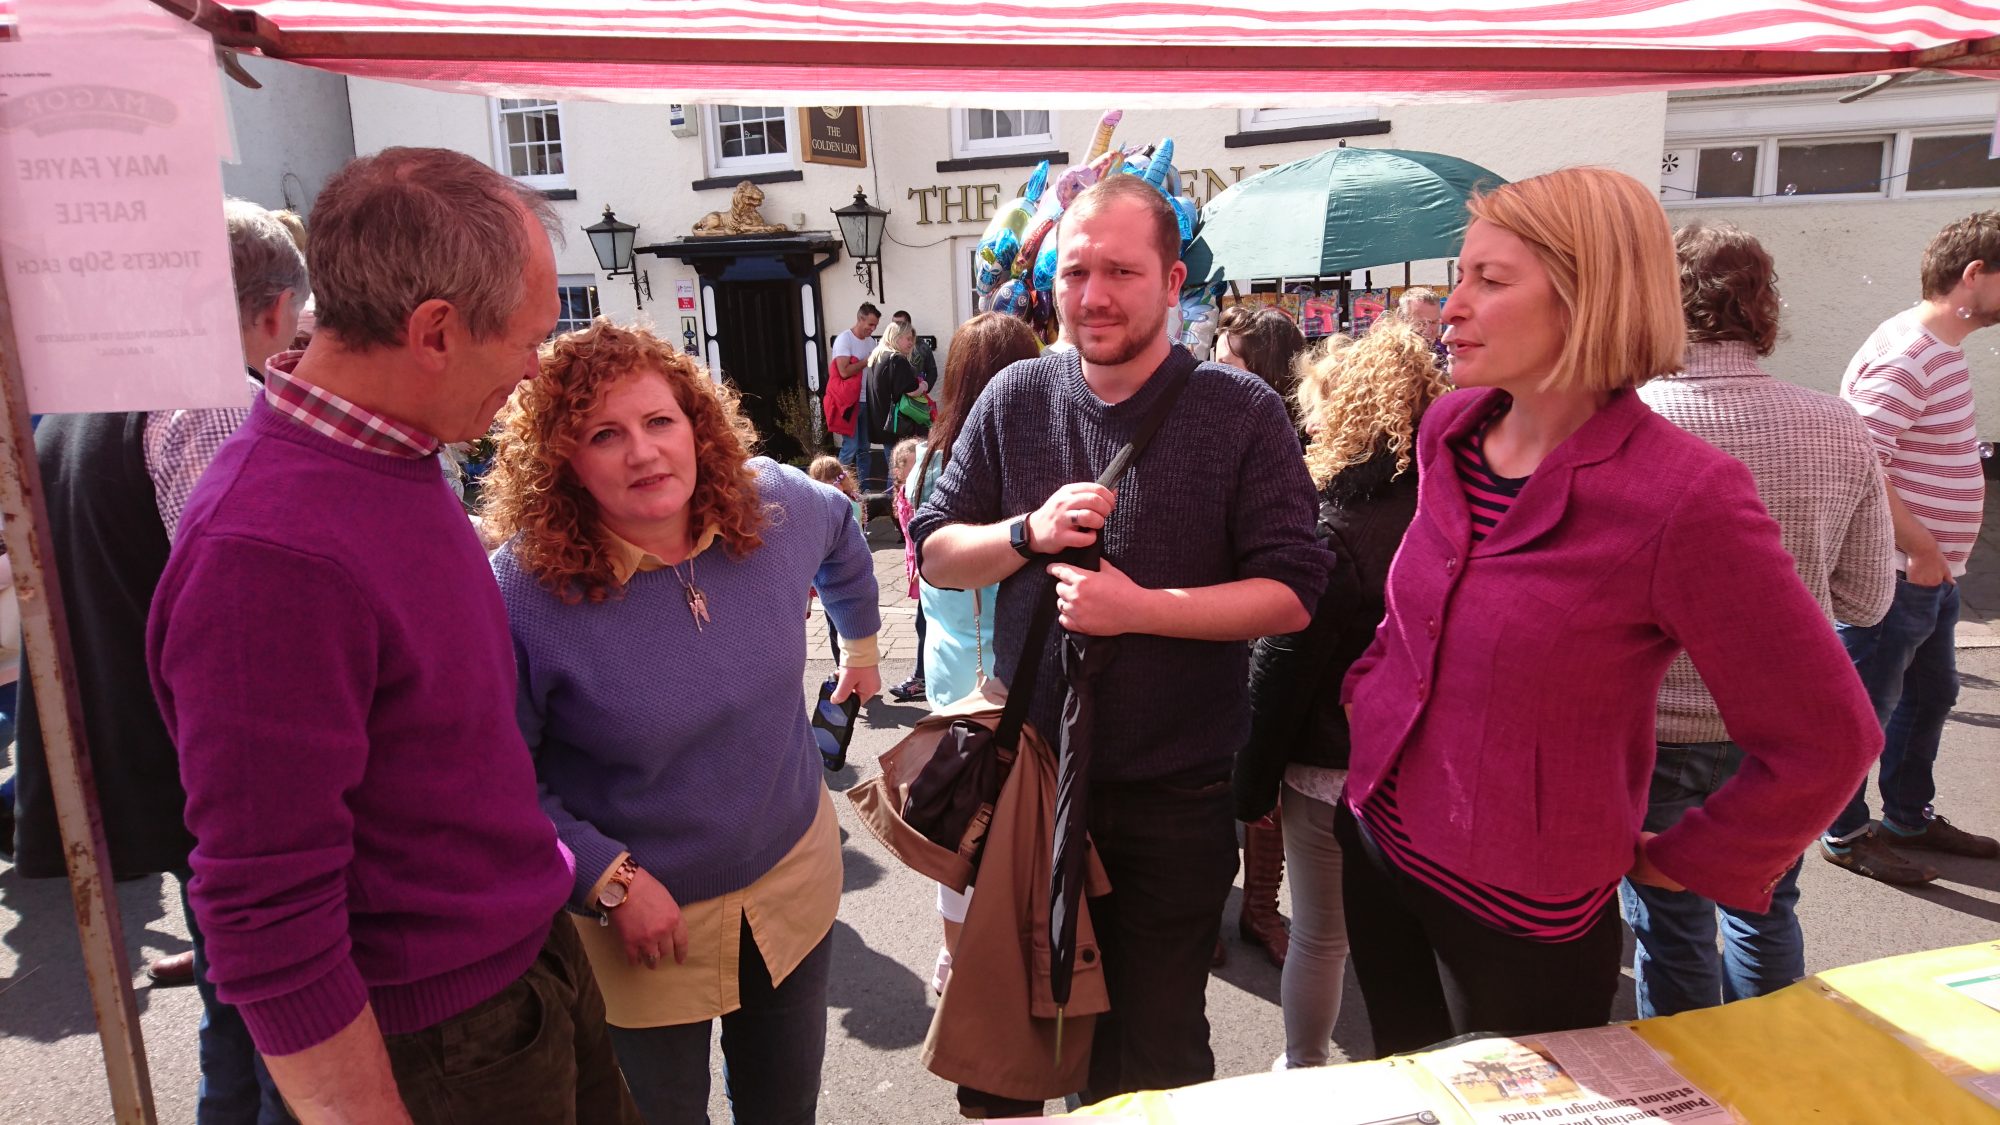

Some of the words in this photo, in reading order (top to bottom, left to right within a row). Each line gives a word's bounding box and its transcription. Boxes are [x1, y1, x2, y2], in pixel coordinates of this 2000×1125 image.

[826, 125, 841, 137] THE
[811, 138, 841, 152] GOLDEN
[841, 142, 858, 154] LION
[907, 183, 1000, 225] THE
[1639, 1087, 1694, 1104] station
[1542, 1108, 1563, 1117] on
[1565, 1099, 1638, 1115] campaign
[1660, 1097, 1711, 1115] Public
[1499, 1111, 1541, 1124] track
